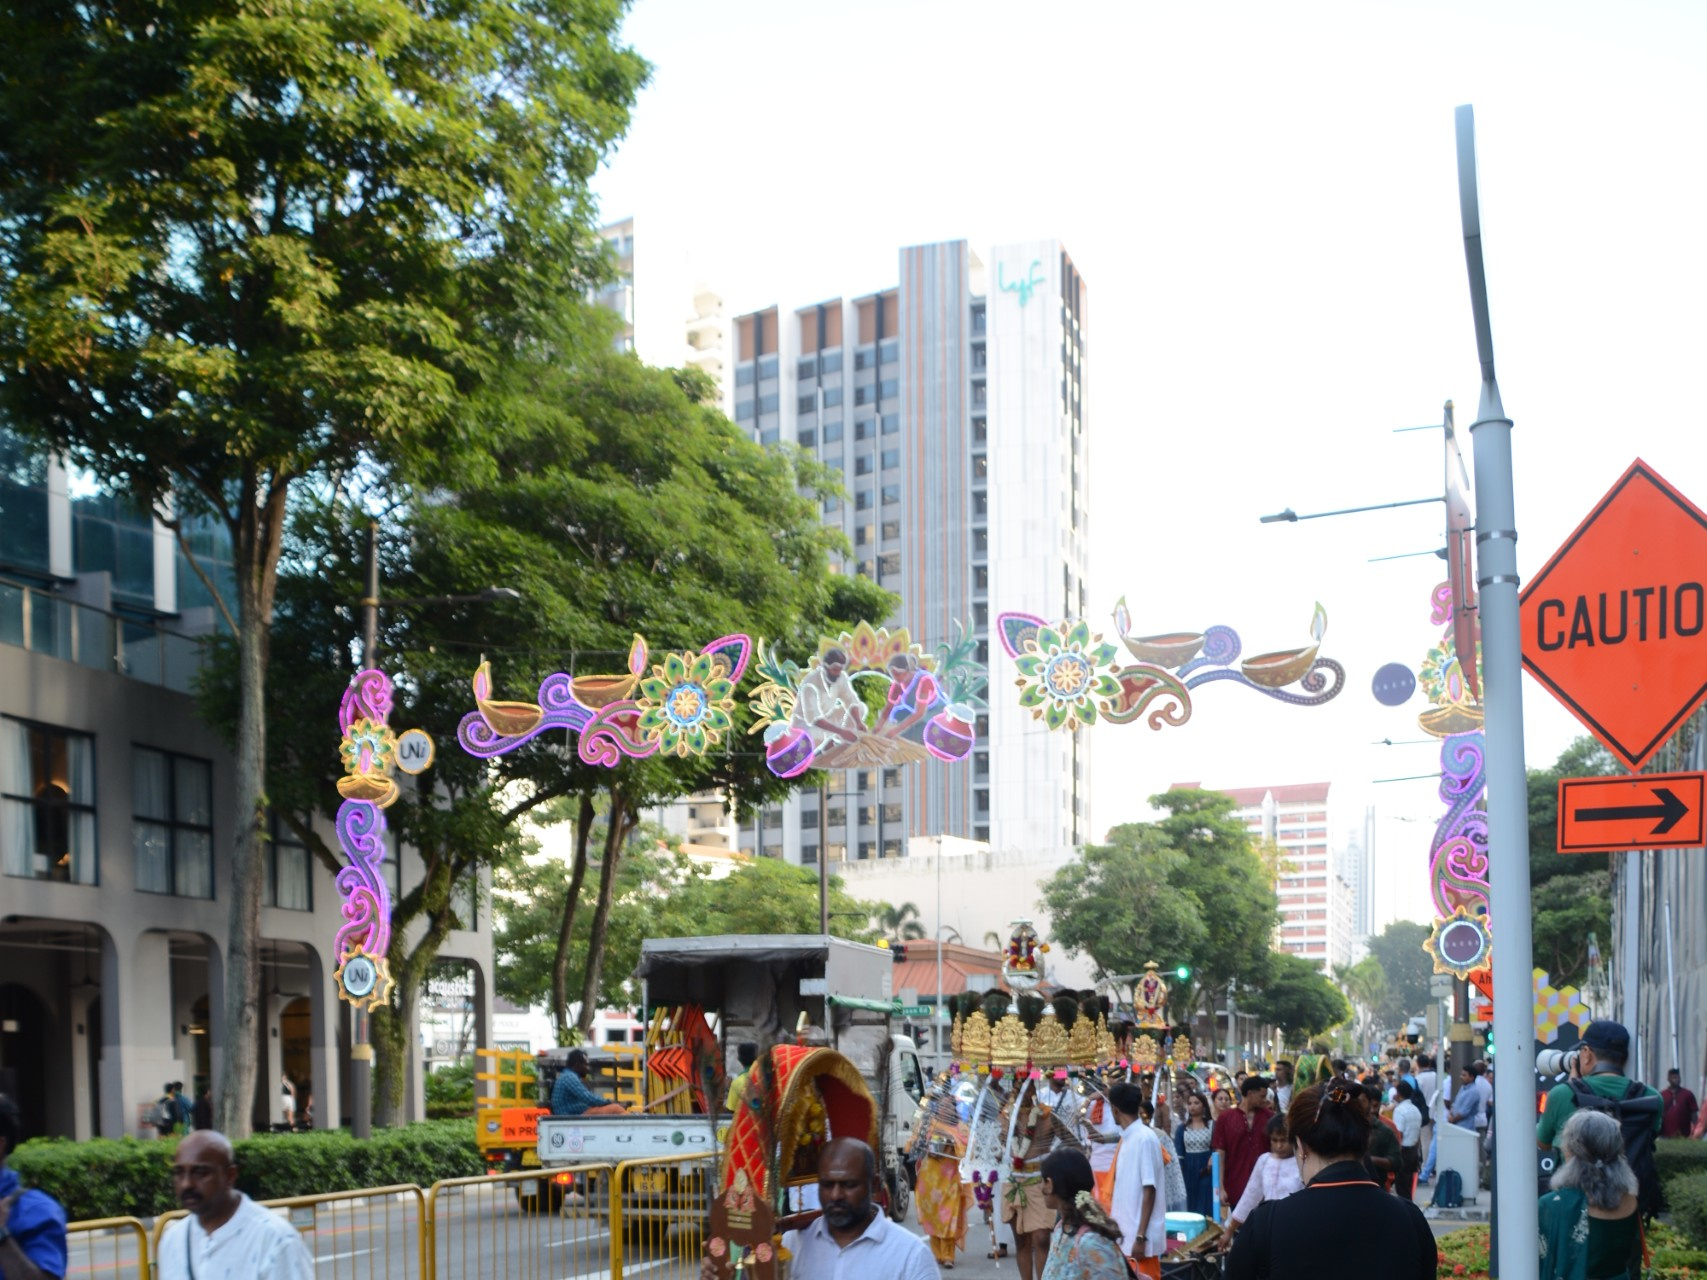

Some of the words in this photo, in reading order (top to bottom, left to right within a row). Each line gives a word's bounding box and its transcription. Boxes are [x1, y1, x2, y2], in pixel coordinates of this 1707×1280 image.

[998, 258, 1046, 308] lyf
[1537, 582, 1704, 652] CAUTIO
[504, 1127, 516, 1136] IN
